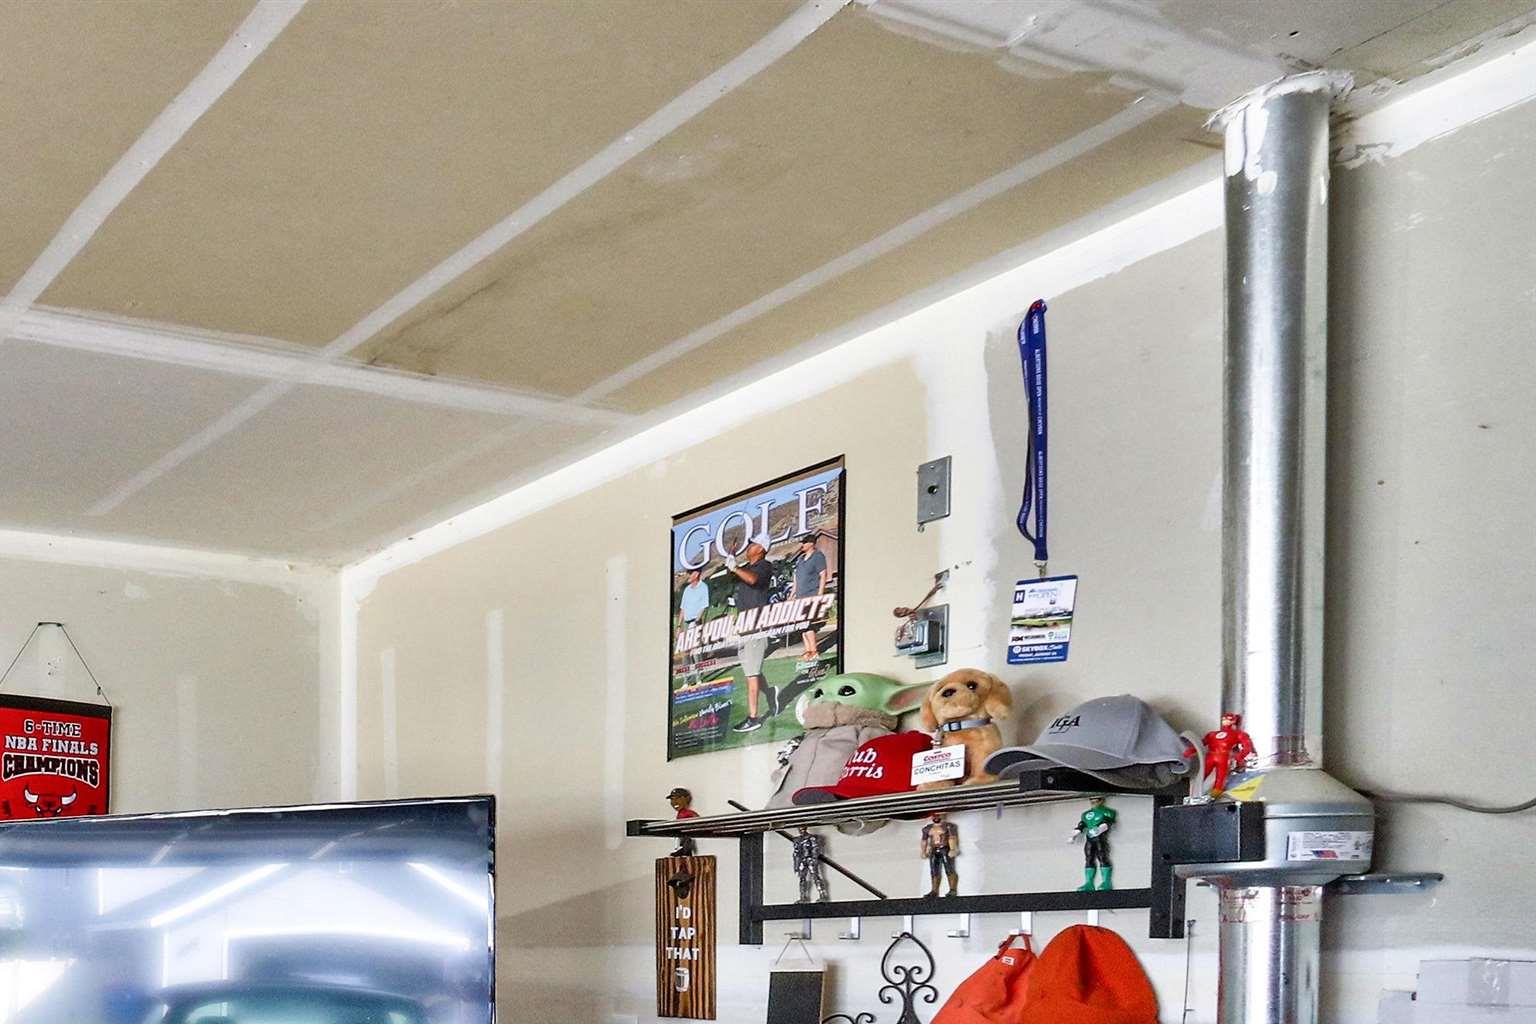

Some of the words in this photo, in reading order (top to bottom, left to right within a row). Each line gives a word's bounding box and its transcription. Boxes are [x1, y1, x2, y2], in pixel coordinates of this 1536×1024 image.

[678, 483, 828, 570] GOLF
[676, 623, 703, 653] ARE
[734, 608, 759, 635] AN
[755, 594, 836, 631] ADDICT?
[23, 718, 82, 737] 6-TIME
[5, 735, 37, 751] NBA
[41, 738, 99, 755] FINALS
[1, 752, 100, 788] CHAMPIONS
[914, 760, 961, 775] CONCHITAS
[675, 905, 692, 919] I'D
[670, 926, 696, 940] TAP
[666, 947, 700, 961] THAT
